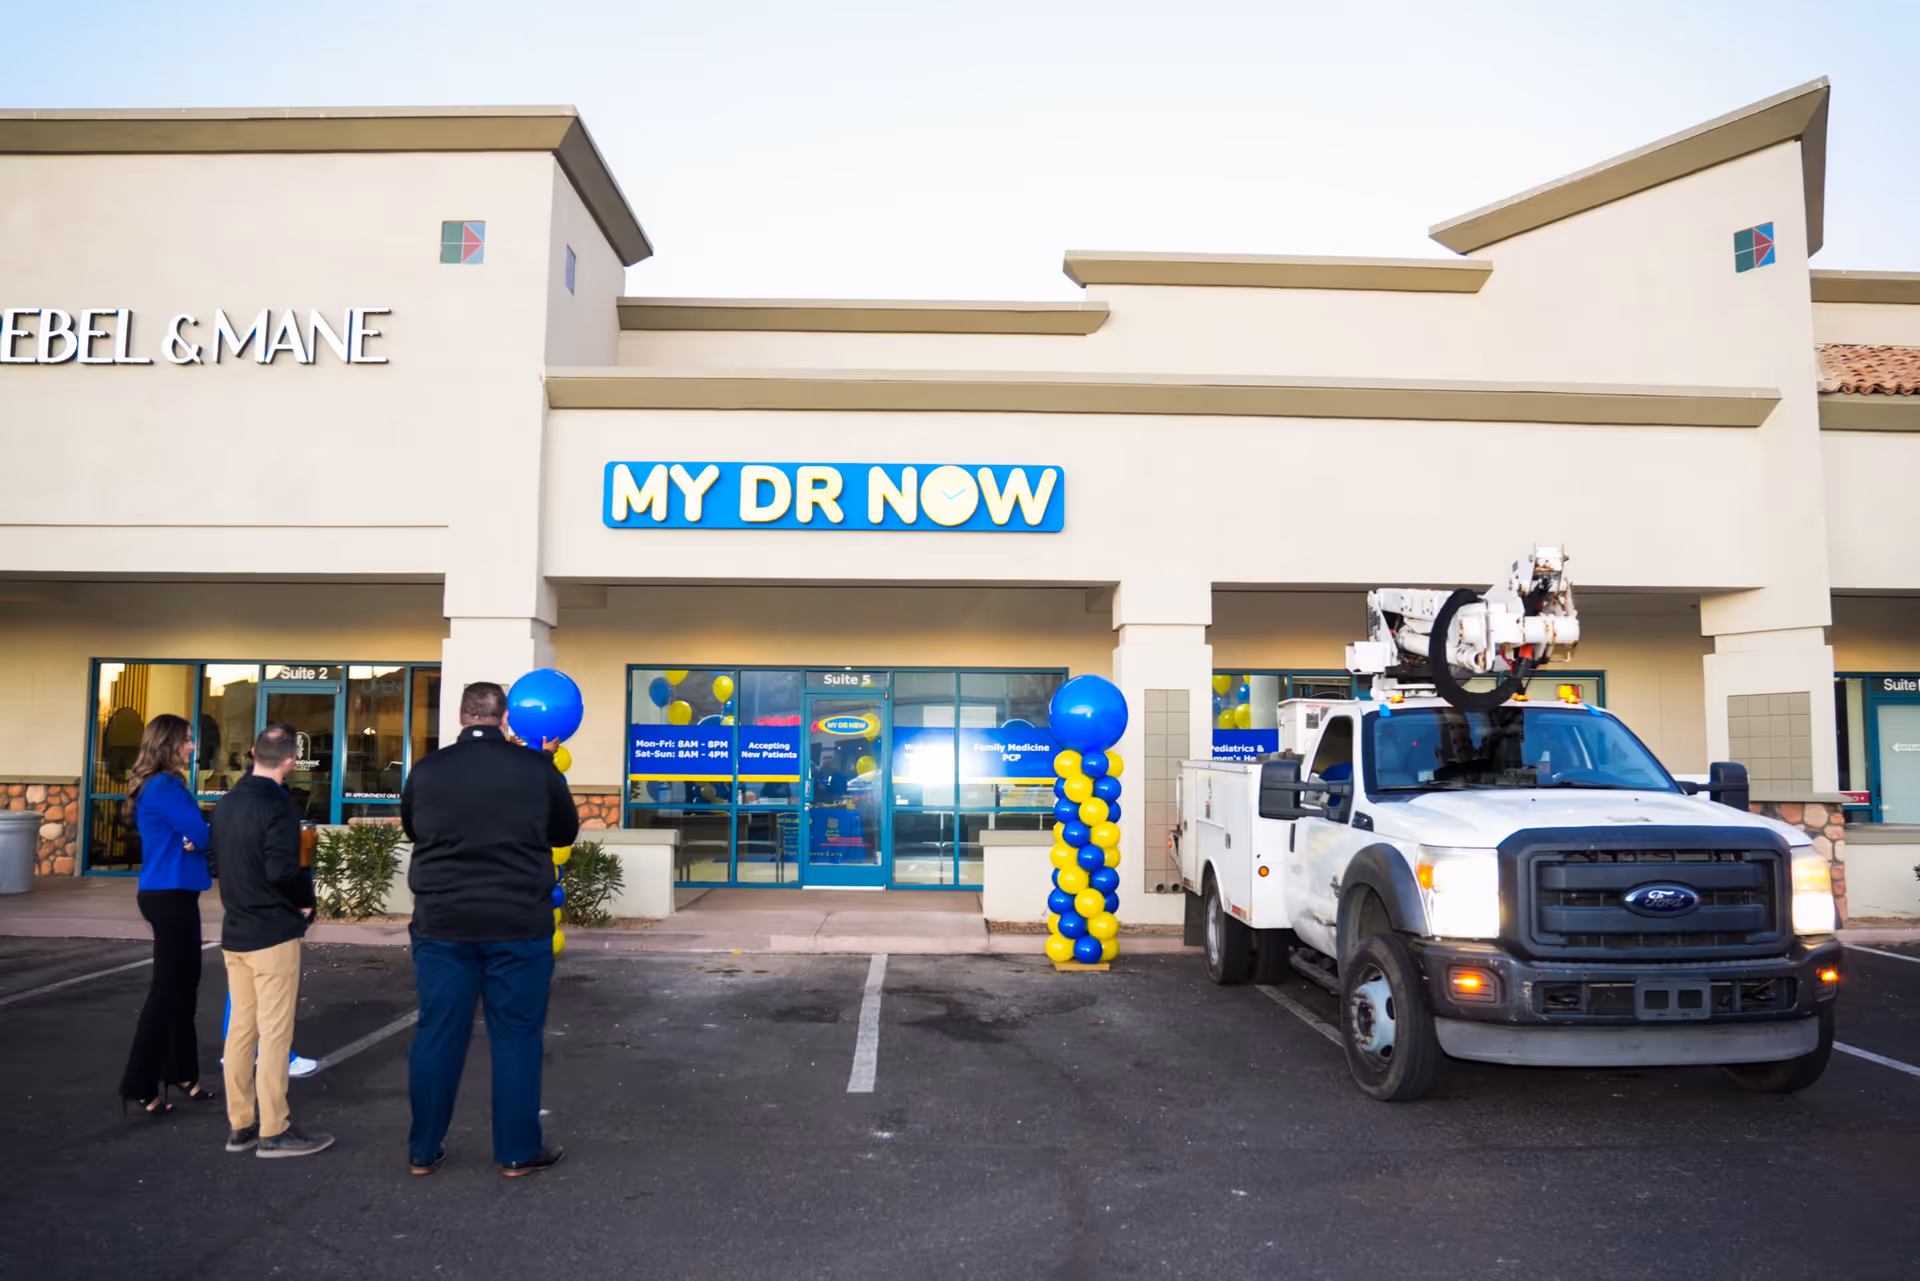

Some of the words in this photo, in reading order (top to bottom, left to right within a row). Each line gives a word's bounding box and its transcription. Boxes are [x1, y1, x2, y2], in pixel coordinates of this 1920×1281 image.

[0, 308, 154, 365] EBEL
[161, 313, 204, 365] &
[212, 307, 392, 364] MANE
[611, 463, 720, 523] MY
[739, 464, 845, 524] DR
[868, 464, 1058, 527] NOW
[280, 666, 315, 680] Suite
[318, 667, 329, 680] 2
[823, 673, 858, 685] Suite
[862, 674, 871, 685] 5
[1883, 678, 1917, 691] Suite
[635, 740, 675, 748] Mon-Fri:
[677, 740, 698, 748] 8AM
[707, 740, 728, 748] 8PM
[748, 742, 790, 751] Accepting
[1007, 743, 1050, 752] Medicine
[1257, 744, 1264, 753] &
[635, 750, 675, 758] Sat-Sun:
[677, 750, 699, 758] 8AM
[708, 750, 728, 758] 4PM
[741, 751, 760, 759] New
[762, 751, 798, 759] Patients
[1002, 753, 1021, 762] PCP
[1644, 890, 1684, 908] Ford
